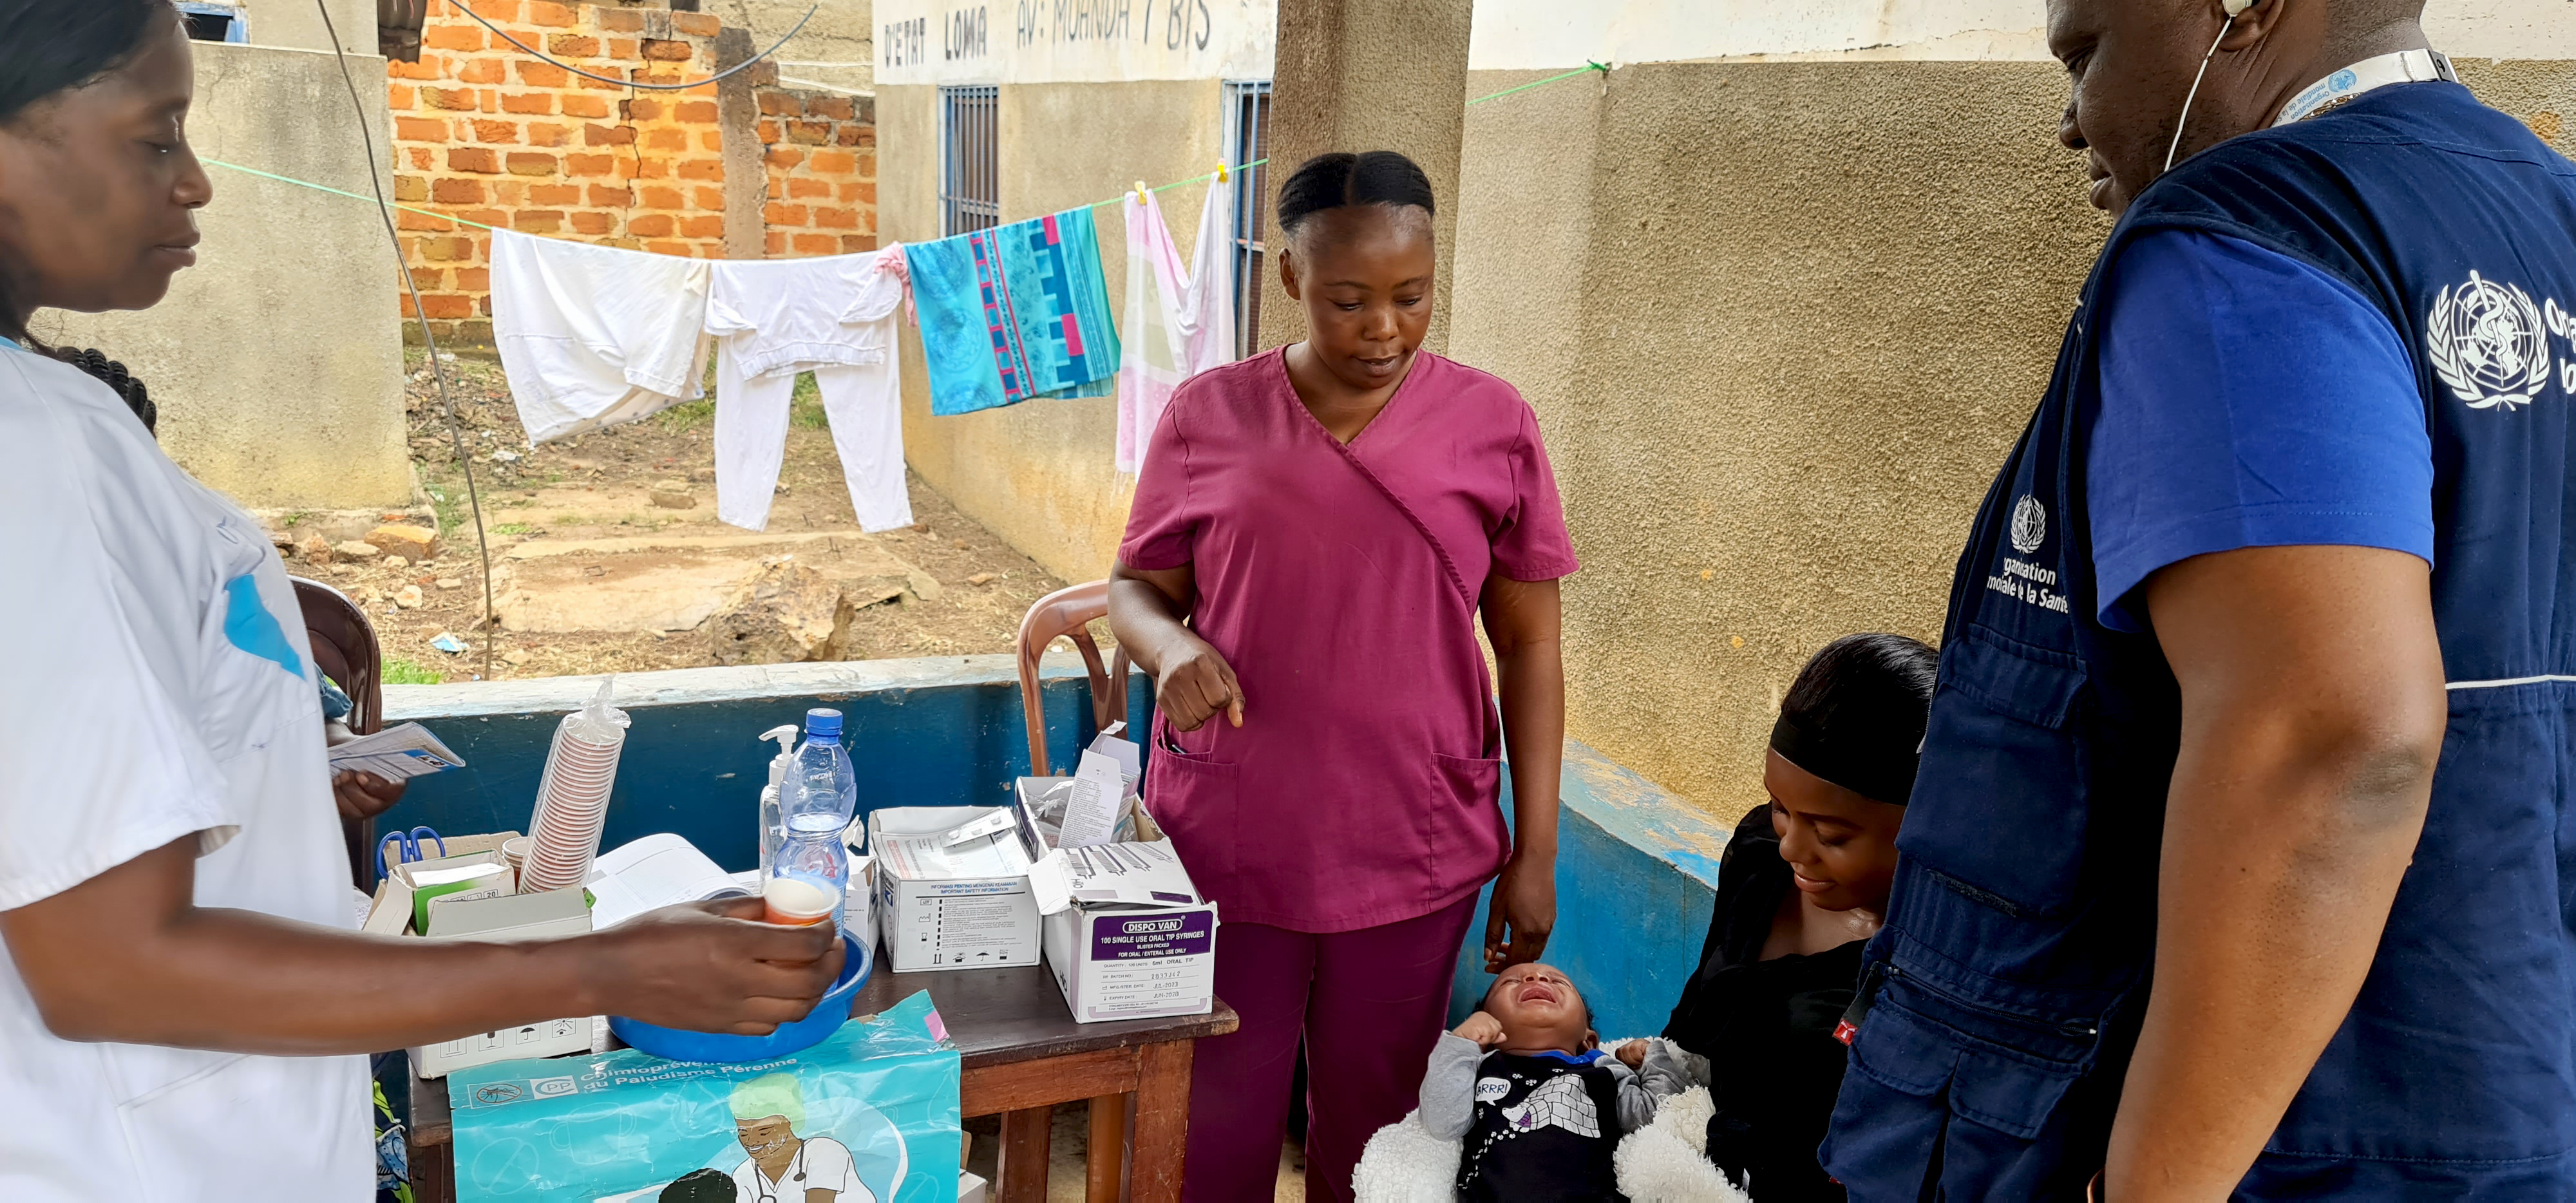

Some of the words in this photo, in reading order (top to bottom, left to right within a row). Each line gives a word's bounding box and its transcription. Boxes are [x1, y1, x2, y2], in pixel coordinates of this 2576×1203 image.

[945, 5, 987, 61] LOMA
[1167, 0, 1210, 50] BIS
[2288, 102, 2297, 111] de
[2290, 91, 2330, 120] Organisation
[2026, 583, 2037, 604] la
[1128, 923, 1155, 932] DISPO
[1159, 921, 1177, 930] VAN
[1176, 931, 1204, 940] SYRINGES
[583, 1079, 609, 1090] du
[615, 1069, 715, 1086] Paludisme
[719, 1057, 798, 1074] Pérenne
